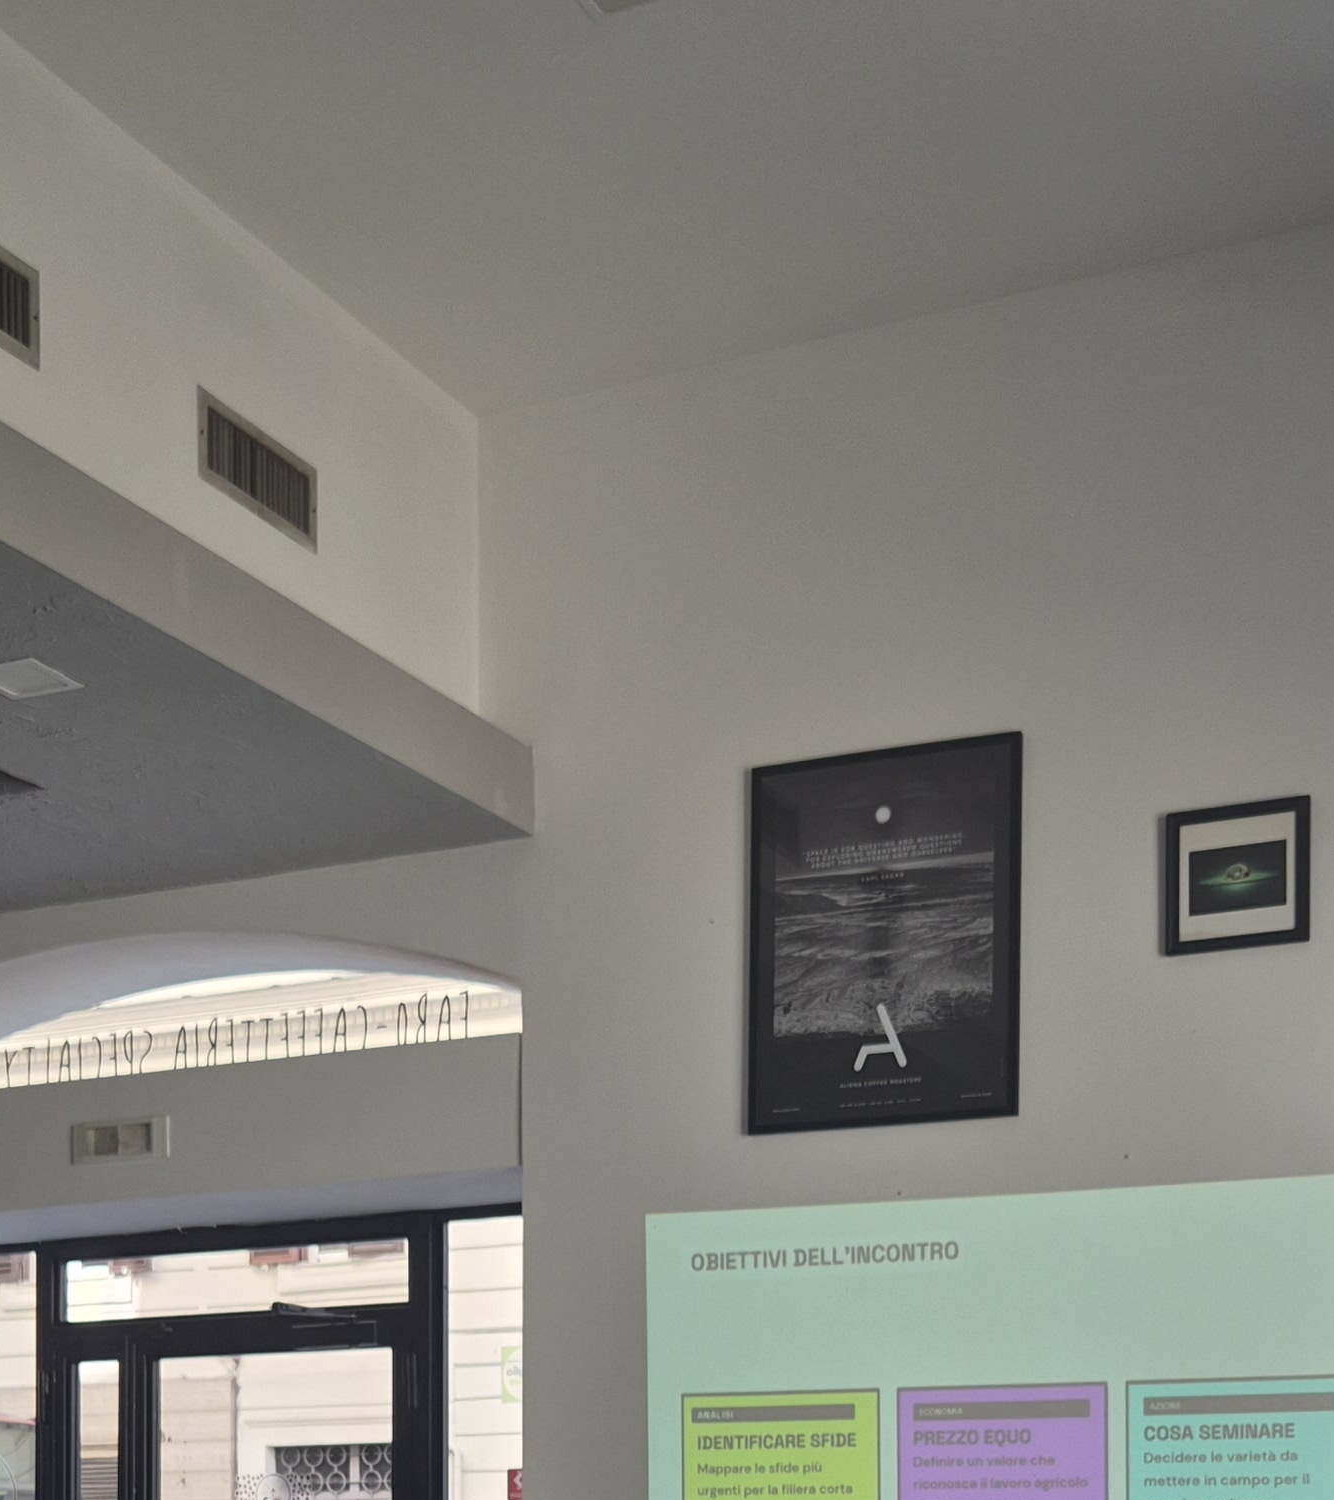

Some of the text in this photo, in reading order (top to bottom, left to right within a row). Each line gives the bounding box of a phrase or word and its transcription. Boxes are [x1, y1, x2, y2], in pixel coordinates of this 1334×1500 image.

[691, 1240, 959, 1272] OBIETTIVI DELL'INCONTRO
[697, 1410, 733, 1420] ANALISI
[913, 1429, 1031, 1447] PREZZO EQUO
[1143, 1422, 1295, 1442] COSA SEMINARE
[697, 1432, 856, 1451] IDENTIFICARE SFIDE
[912, 1455, 1055, 1468] Definire un valore che
[1143, 1450, 1298, 1464] Decidere le varietà da
[697, 1461, 822, 1477] Mappare le sfide più
[913, 1478, 977, 1489] riconosca
[990, 1477, 1031, 1488] lavoro
[1034, 1476, 1088, 1491] agricolo
[1143, 1473, 1310, 1488] mettere in campo per il
[697, 1484, 853, 1498] urgenti per la filiera corta
